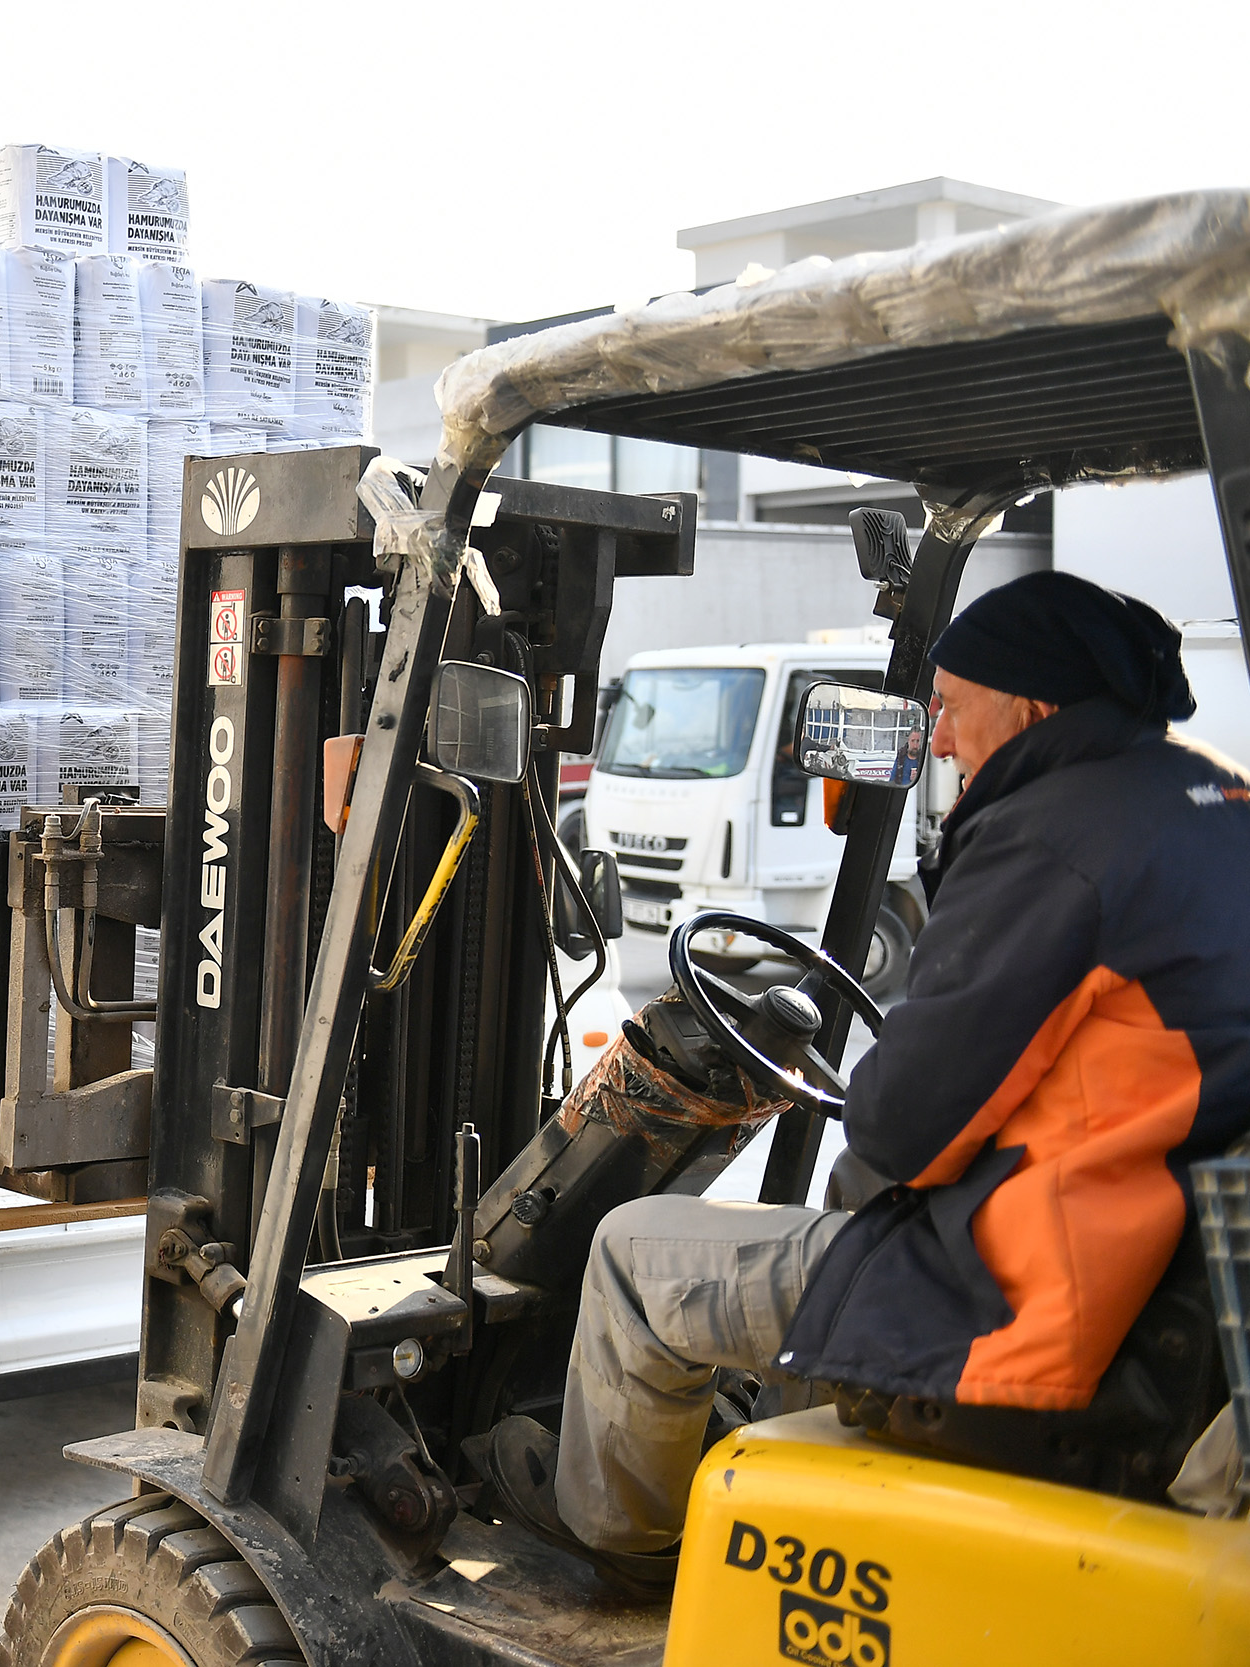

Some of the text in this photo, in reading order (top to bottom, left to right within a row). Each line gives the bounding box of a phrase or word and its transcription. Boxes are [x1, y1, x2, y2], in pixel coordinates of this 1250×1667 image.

[35, 194, 102, 215] HAMURUMUZDA
[35, 208, 102, 229] DAYANIŞMA VAR
[128, 213, 188, 232] HAMURUMUZDA
[128, 227, 175, 243] DAYANIŞMA
[171, 266, 190, 281] TESTA
[48, 364, 56, 373] kg
[278, 356, 291, 371] VAR
[18, 475, 36, 488] VAR
[221, 592, 243, 601] WARNING
[9, 779, 28, 792] VAR
[619, 832, 667, 851] IVECO
[197, 715, 235, 1009] DAEWOO
[724, 1519, 893, 1614] D30S
[784, 1607, 886, 1667] odb
